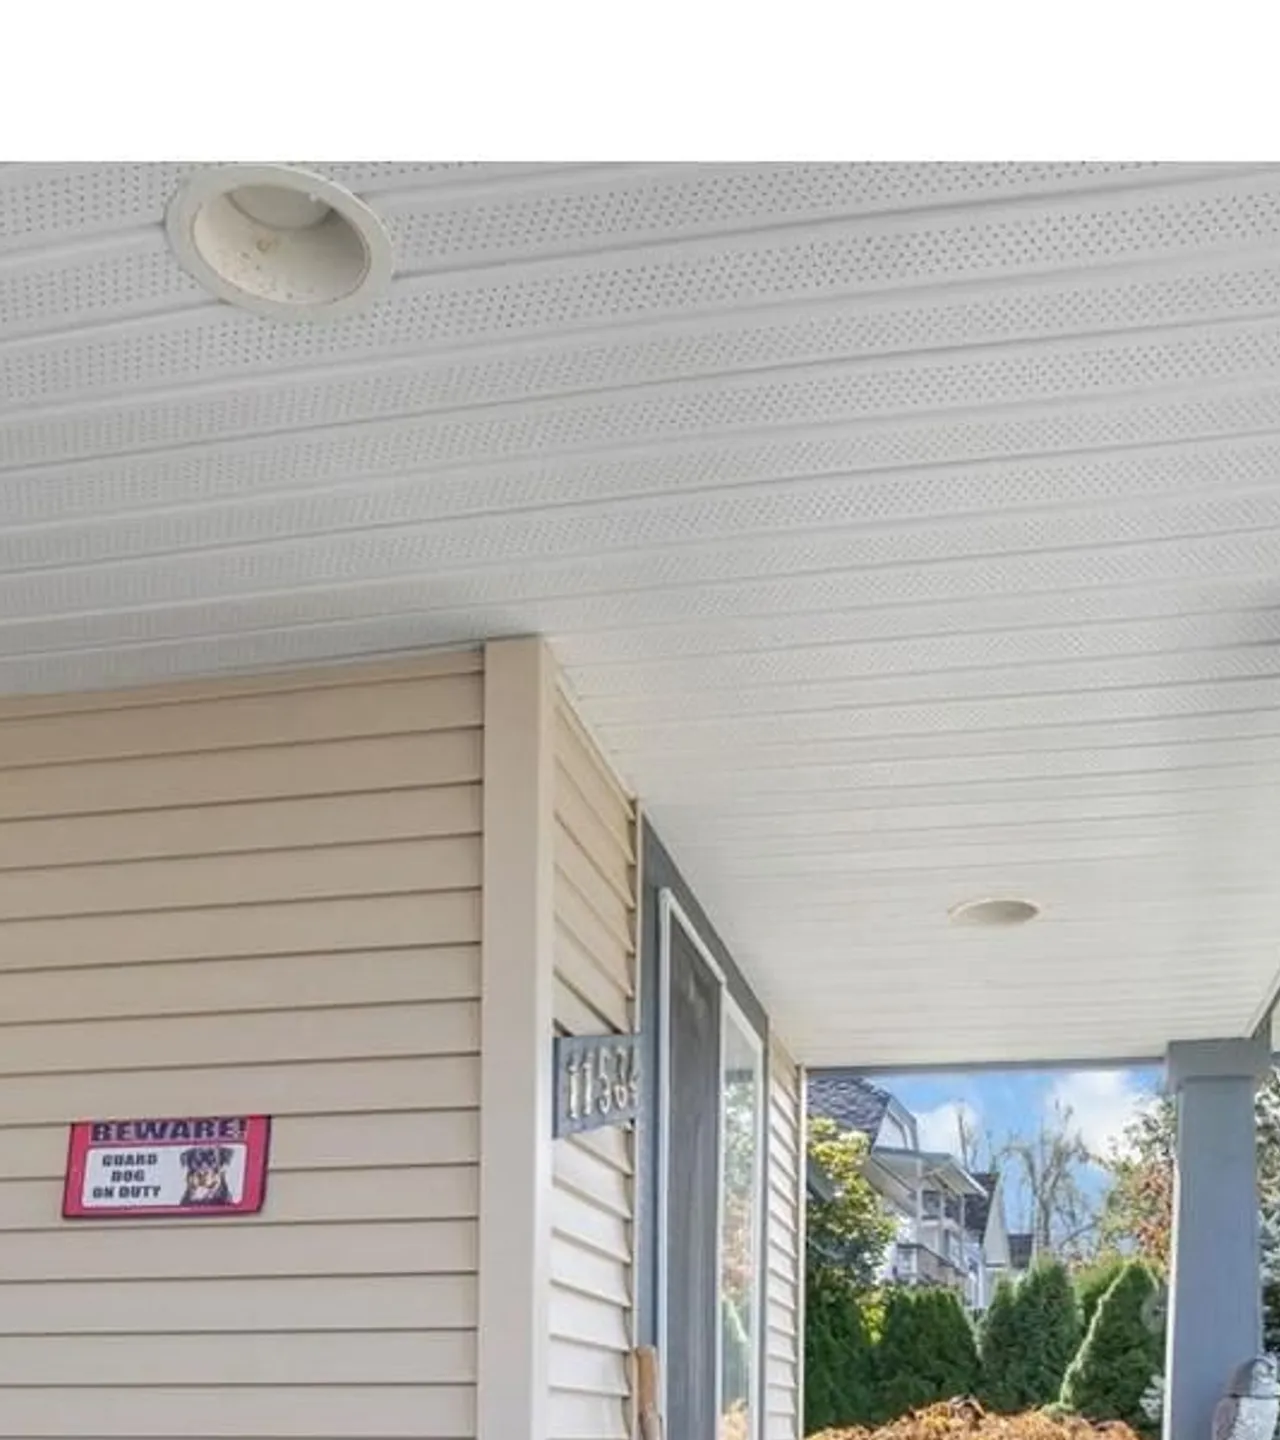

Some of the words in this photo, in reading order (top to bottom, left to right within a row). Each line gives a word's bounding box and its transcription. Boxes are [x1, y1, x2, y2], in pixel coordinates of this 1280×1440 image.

[91, 1118, 247, 1142] BEWARE!
[102, 1153, 159, 1167] GUARD
[110, 1169, 146, 1183] DOG
[92, 1186, 116, 1199] ON
[118, 1185, 161, 1198] DUTY
